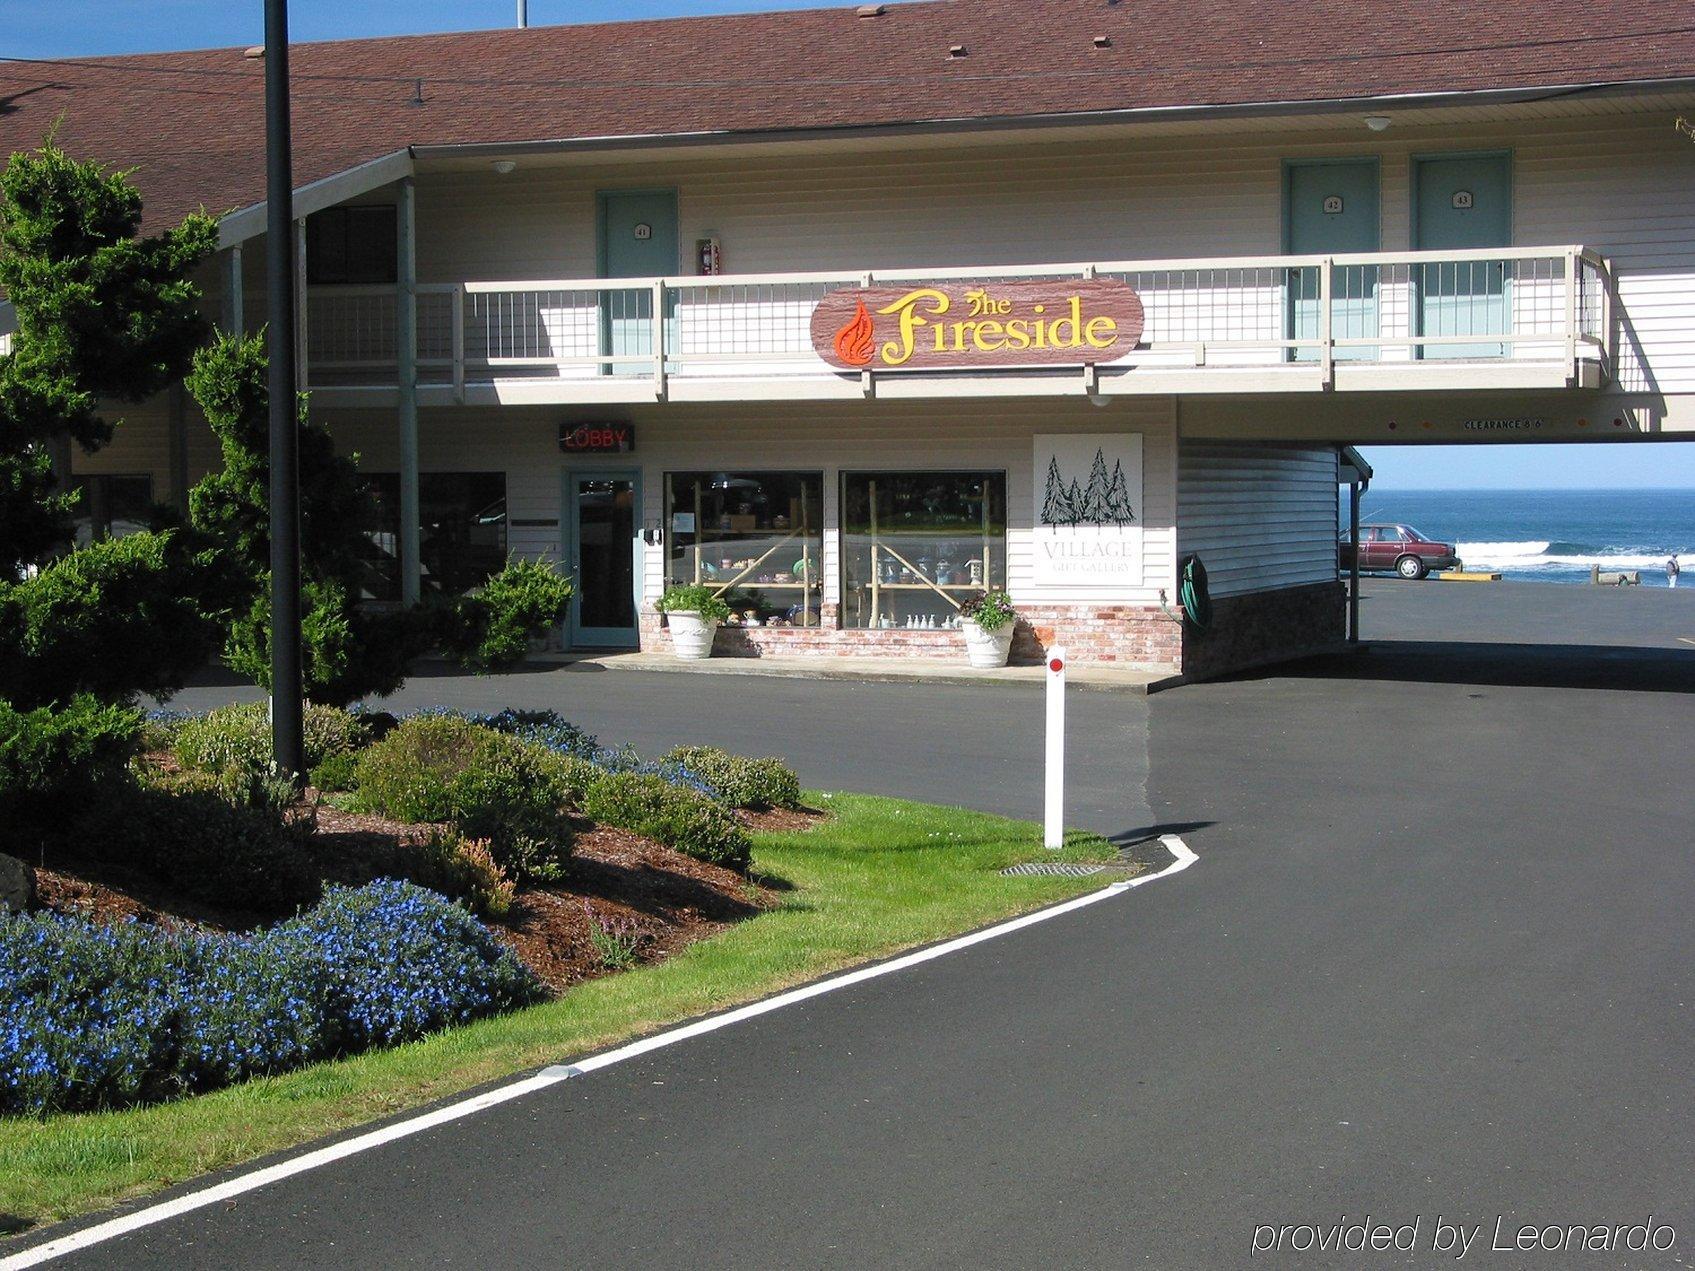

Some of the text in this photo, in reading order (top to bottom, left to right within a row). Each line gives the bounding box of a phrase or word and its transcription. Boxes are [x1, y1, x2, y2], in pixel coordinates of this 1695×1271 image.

[965, 288, 1012, 317] The
[877, 288, 1118, 365] Fireside
[1464, 419, 1520, 430] CLEARANCE
[565, 428, 626, 448] LOBBY
[1043, 541, 1132, 559] VILLAGE
